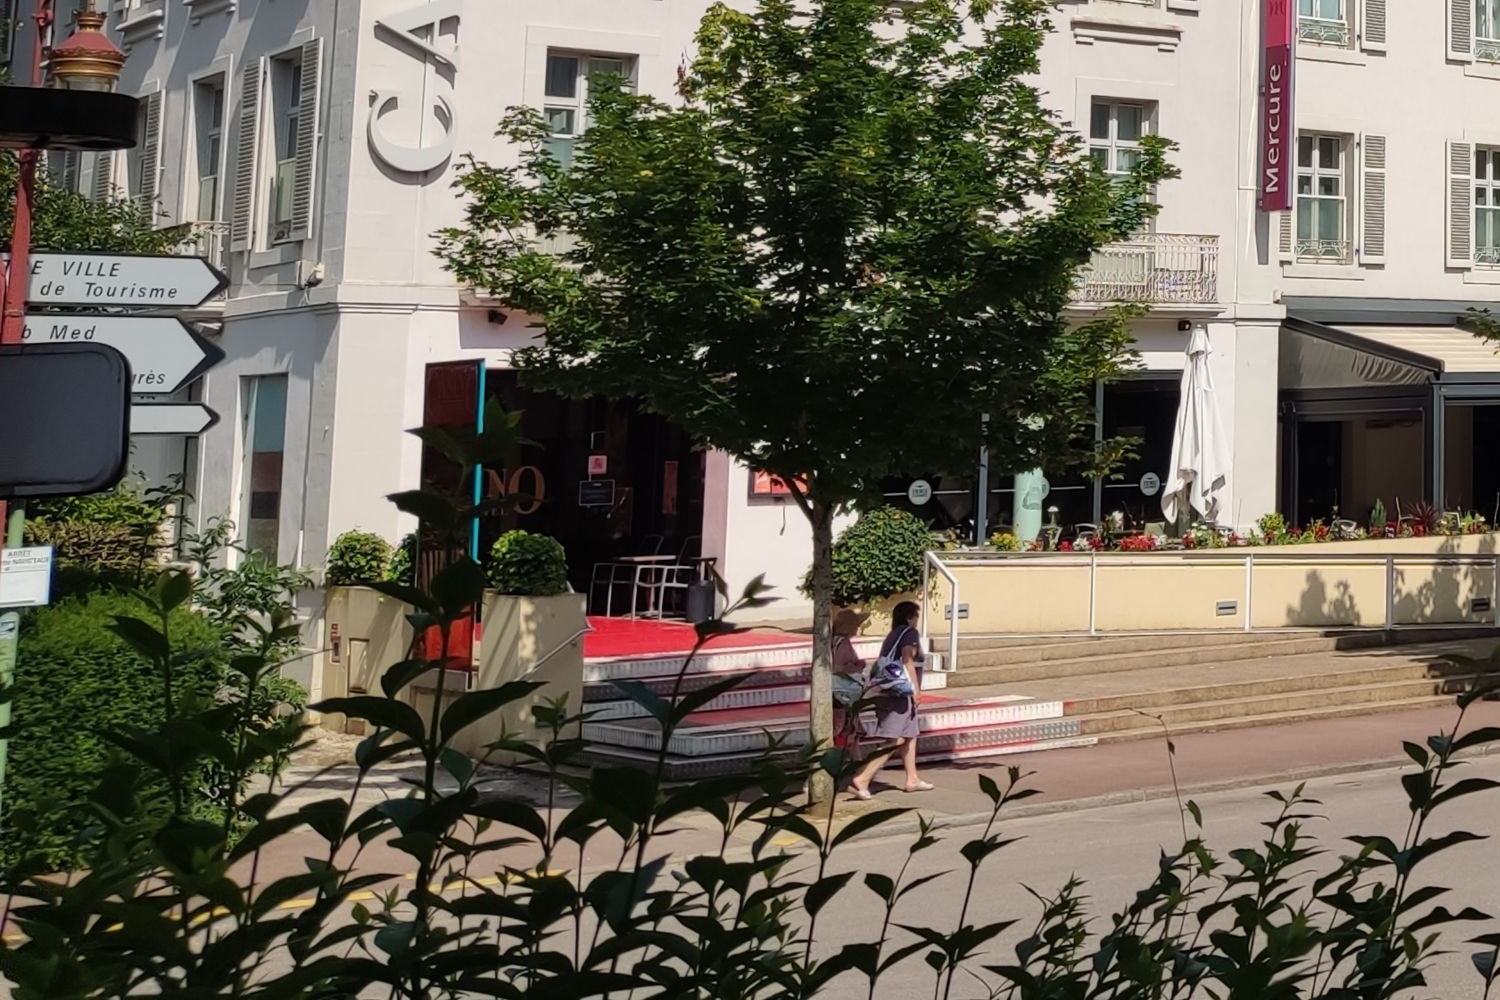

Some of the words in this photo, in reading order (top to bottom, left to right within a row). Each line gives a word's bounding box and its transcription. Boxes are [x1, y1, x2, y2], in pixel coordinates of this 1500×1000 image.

[1265, 64, 1281, 193] Mercure
[63, 261, 121, 277] VILLE
[40, 281, 65, 296] de
[85, 281, 178, 298] Tourisme
[49, 324, 97, 340] Med
